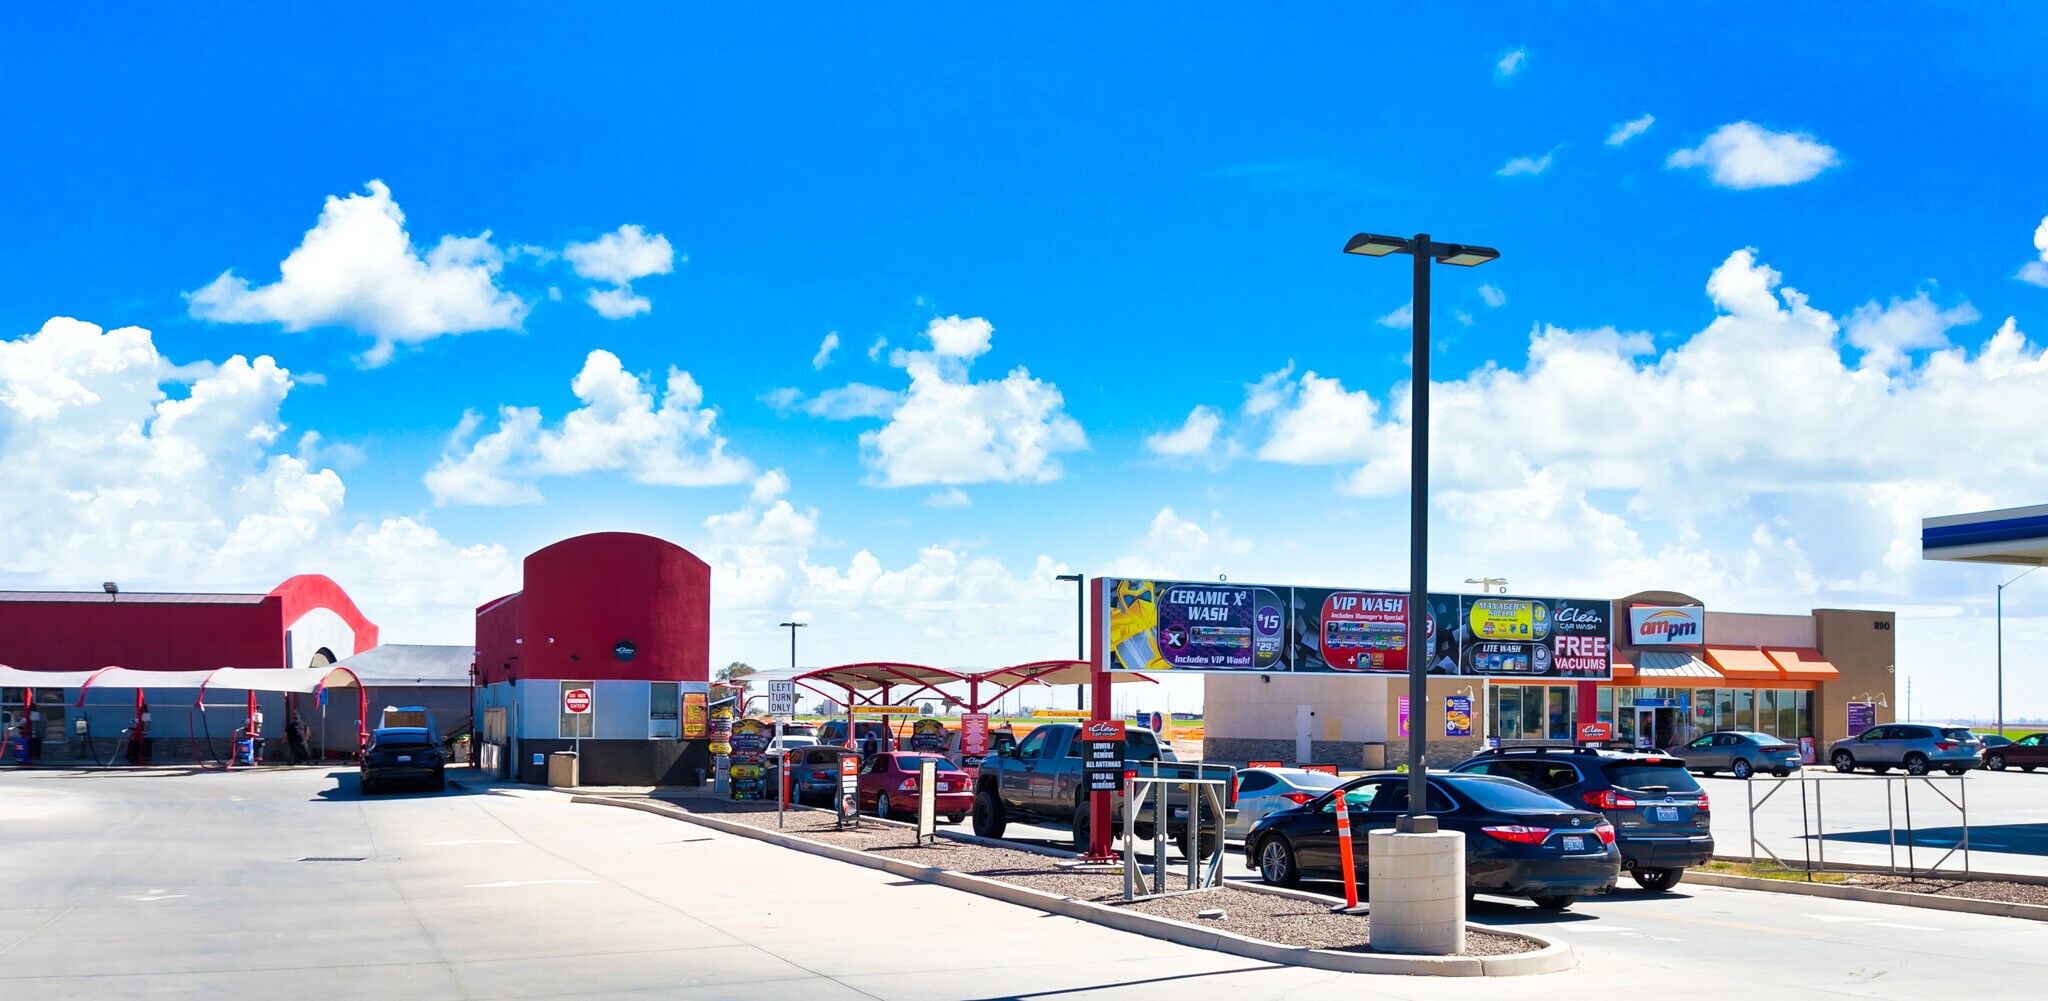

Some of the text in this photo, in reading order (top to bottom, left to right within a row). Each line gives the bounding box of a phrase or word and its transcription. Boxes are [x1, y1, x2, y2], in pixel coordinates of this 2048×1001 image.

[1170, 590, 1230, 606] CERAMIC
[1332, 596, 1403, 612] VIP WASH
[1479, 602, 1527, 611] MANAGER'S
[1188, 606, 1229, 621] WASH
[1355, 613, 1382, 621] Manager's
[1383, 613, 1405, 621] Special!
[1488, 609, 1516, 617] SPECIAL
[1554, 607, 1602, 623] iClean
[1257, 614, 1279, 629] $15
[1560, 623, 1575, 631] CAR
[1640, 619, 1696, 642] ampm
[1482, 644, 1522, 653] LITE WASH
[1555, 635, 1606, 657] FREE
[1174, 655, 1251, 665] Includes VIP Wash!
[1554, 657, 1606, 670] VACUUMS
[771, 683, 791, 692] LEFT
[771, 693, 791, 702] TURN
[771, 703, 791, 712] ONLY
[1088, 721, 1120, 732] iClean
[1093, 742, 1110, 750] LOWER
